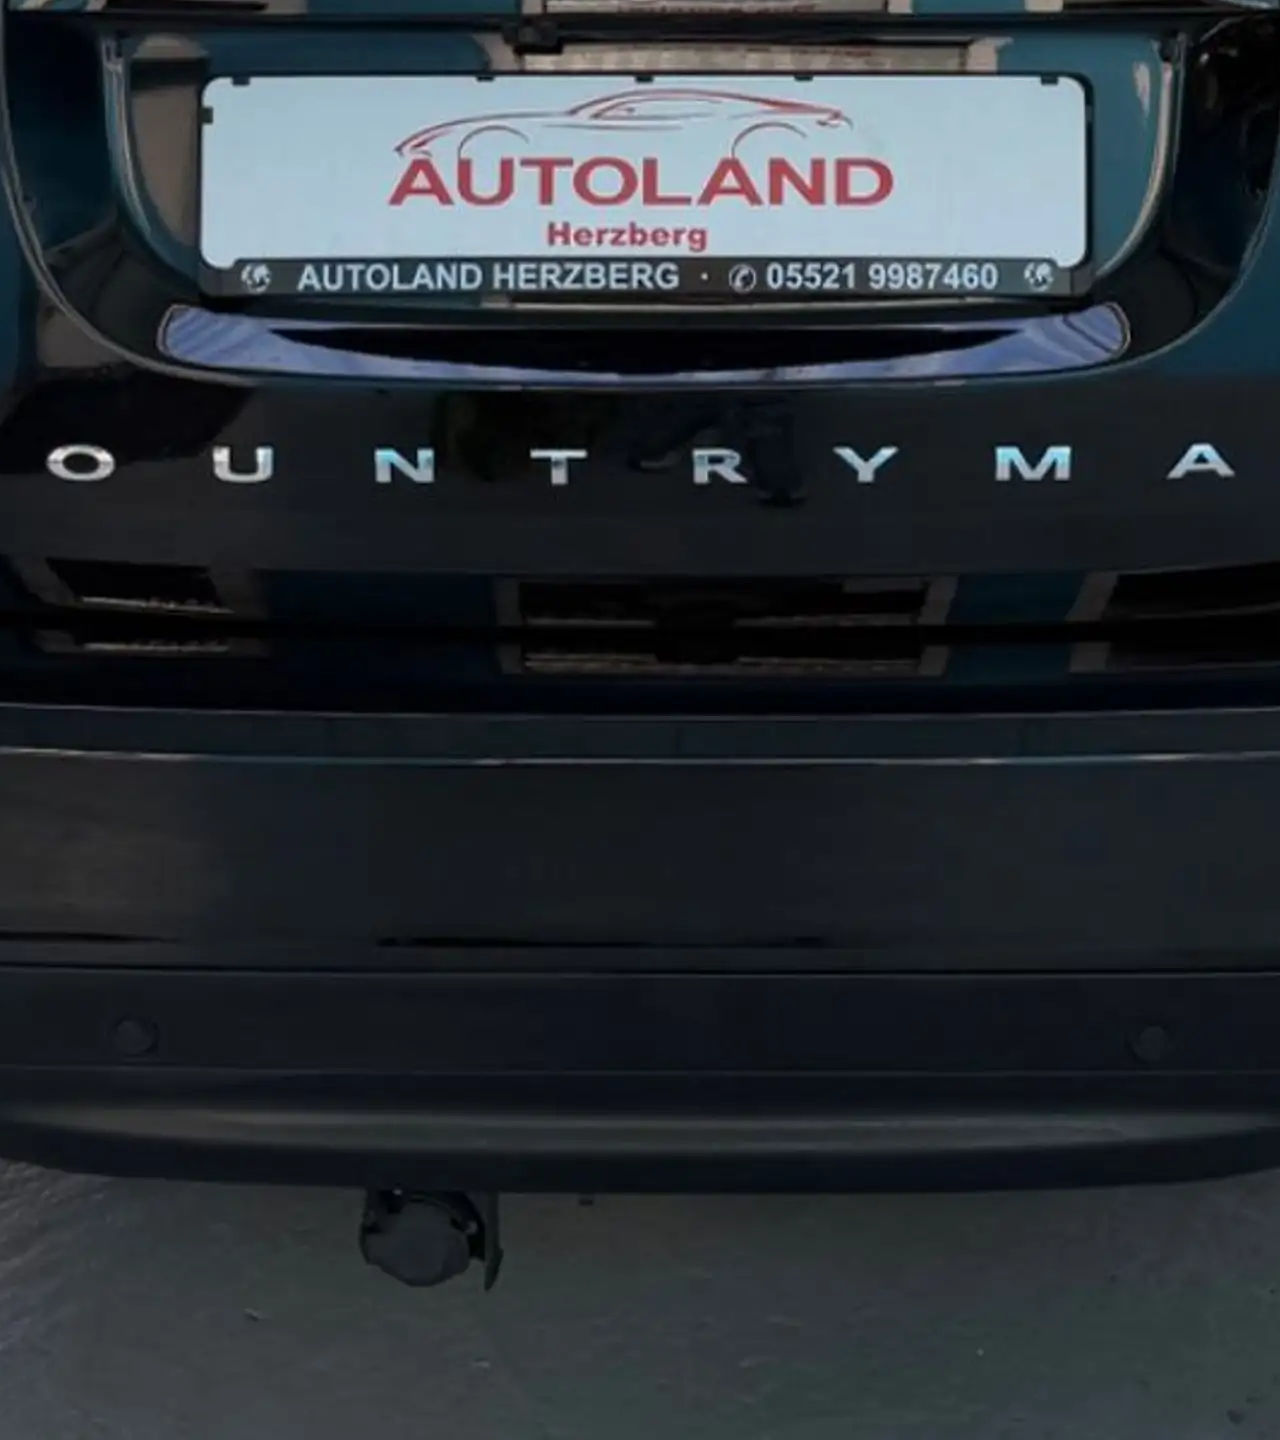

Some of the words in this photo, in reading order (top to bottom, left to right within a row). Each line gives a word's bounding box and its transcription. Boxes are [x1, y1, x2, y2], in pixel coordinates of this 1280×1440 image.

[389, 157, 893, 206] AUTOLAND
[547, 222, 708, 252] Herzberg
[297, 263, 482, 290] AUTOLAND
[492, 262, 680, 290] HERZBERG
[765, 263, 856, 290] 05521
[868, 262, 999, 290] 9987460
